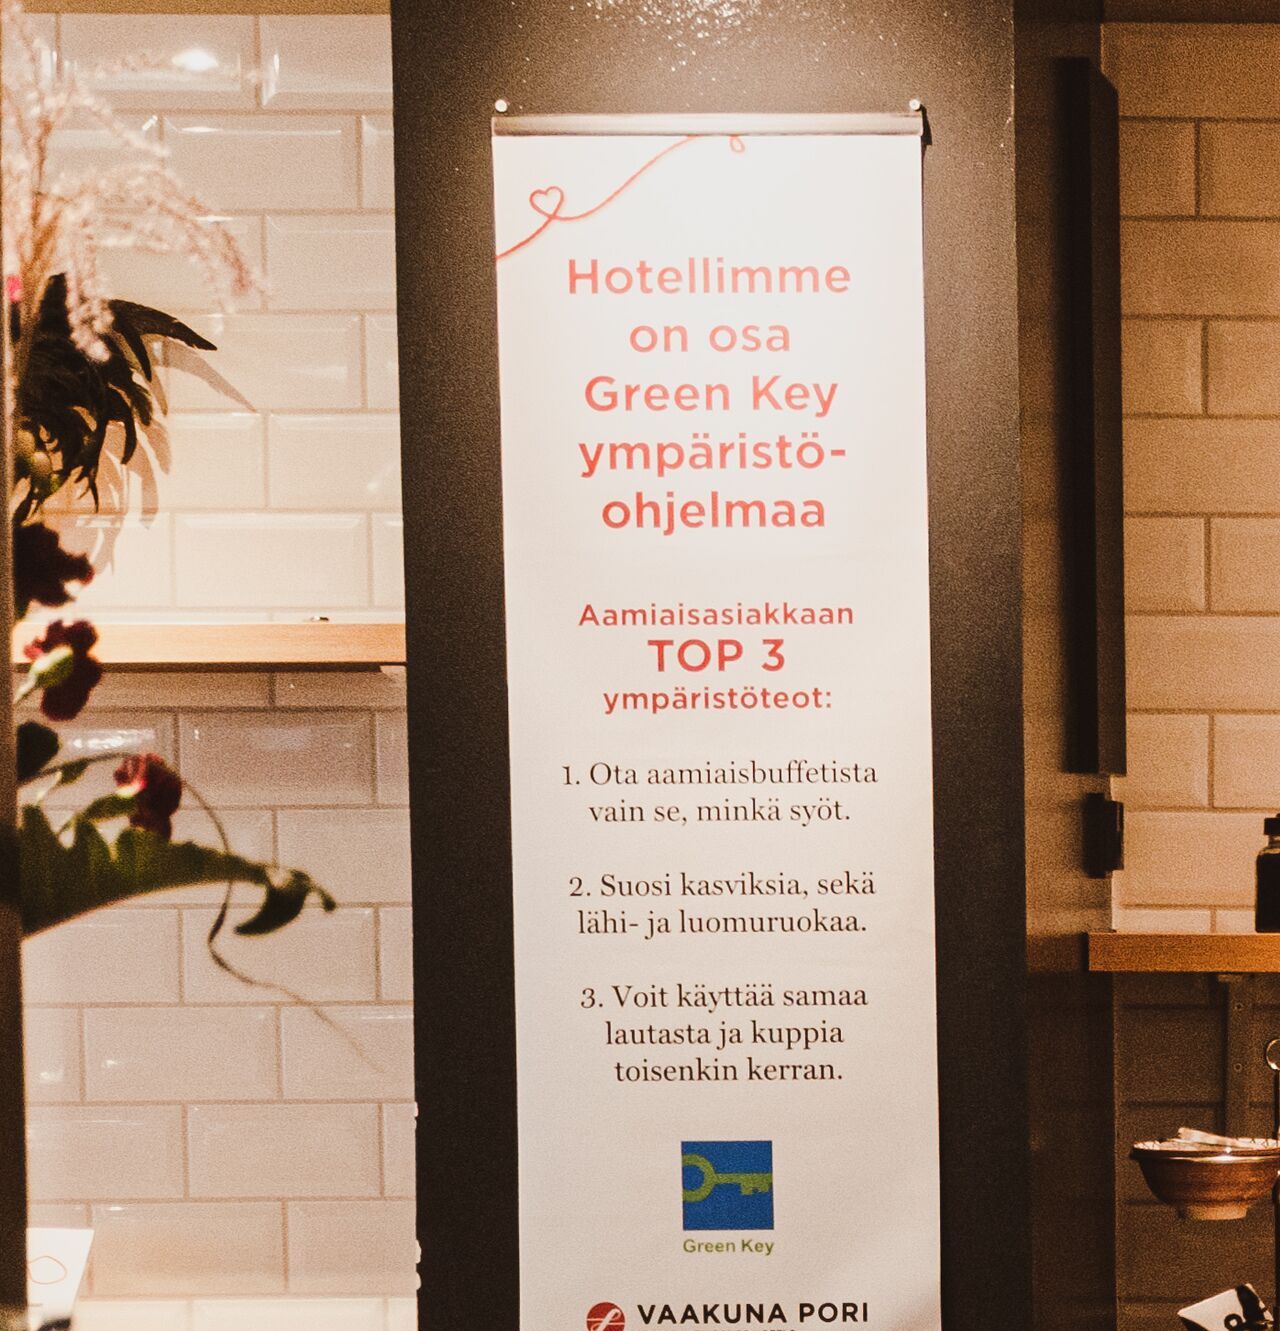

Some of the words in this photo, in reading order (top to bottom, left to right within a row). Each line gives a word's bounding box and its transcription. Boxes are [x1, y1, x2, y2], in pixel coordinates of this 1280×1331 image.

[568, 258, 850, 294] Hotellimme
[630, 325, 687, 352] on
[709, 325, 790, 352] osa
[585, 376, 729, 412] Green
[753, 376, 837, 417] Key
[579, 433, 845, 478] ympäristö-
[602, 491, 824, 535] ohjelmaa
[579, 603, 853, 626] Aamiaisasiakkaan
[648, 639, 743, 672] TOP
[762, 639, 784, 671] 3
[604, 687, 830, 715] ympäristöteot:
[563, 766, 580, 785] 1.
[590, 764, 637, 784] Ota
[648, 759, 877, 784] aamiaisbuffetista
[589, 799, 644, 822] vain
[654, 807, 687, 827] se,
[698, 797, 780, 821] minkä
[791, 797, 849, 827] syöt.
[569, 877, 591, 897] 2.
[601, 873, 670, 896] Suosi
[681, 871, 808, 899] kasviksia,
[818, 871, 875, 894] sekä
[579, 910, 638, 934] lähi-
[644, 911, 670, 939] ja
[680, 908, 866, 933] luomuruokaa.
[581, 988, 603, 1008] 3.
[613, 985, 667, 1007] Voit
[677, 983, 774, 1013] käyttää
[784, 990, 867, 1006] samaa
[606, 1021, 710, 1044] lautasta
[716, 1021, 742, 1051] ja
[752, 1019, 843, 1050] kuppia
[615, 1058, 737, 1081] toisenkin
[747, 1057, 842, 1080] kerran.
[683, 1239, 736, 1253] Green
[741, 1240, 774, 1256] Key
[638, 1303, 787, 1324] VAAKUNA
[799, 1303, 867, 1323] PORI
